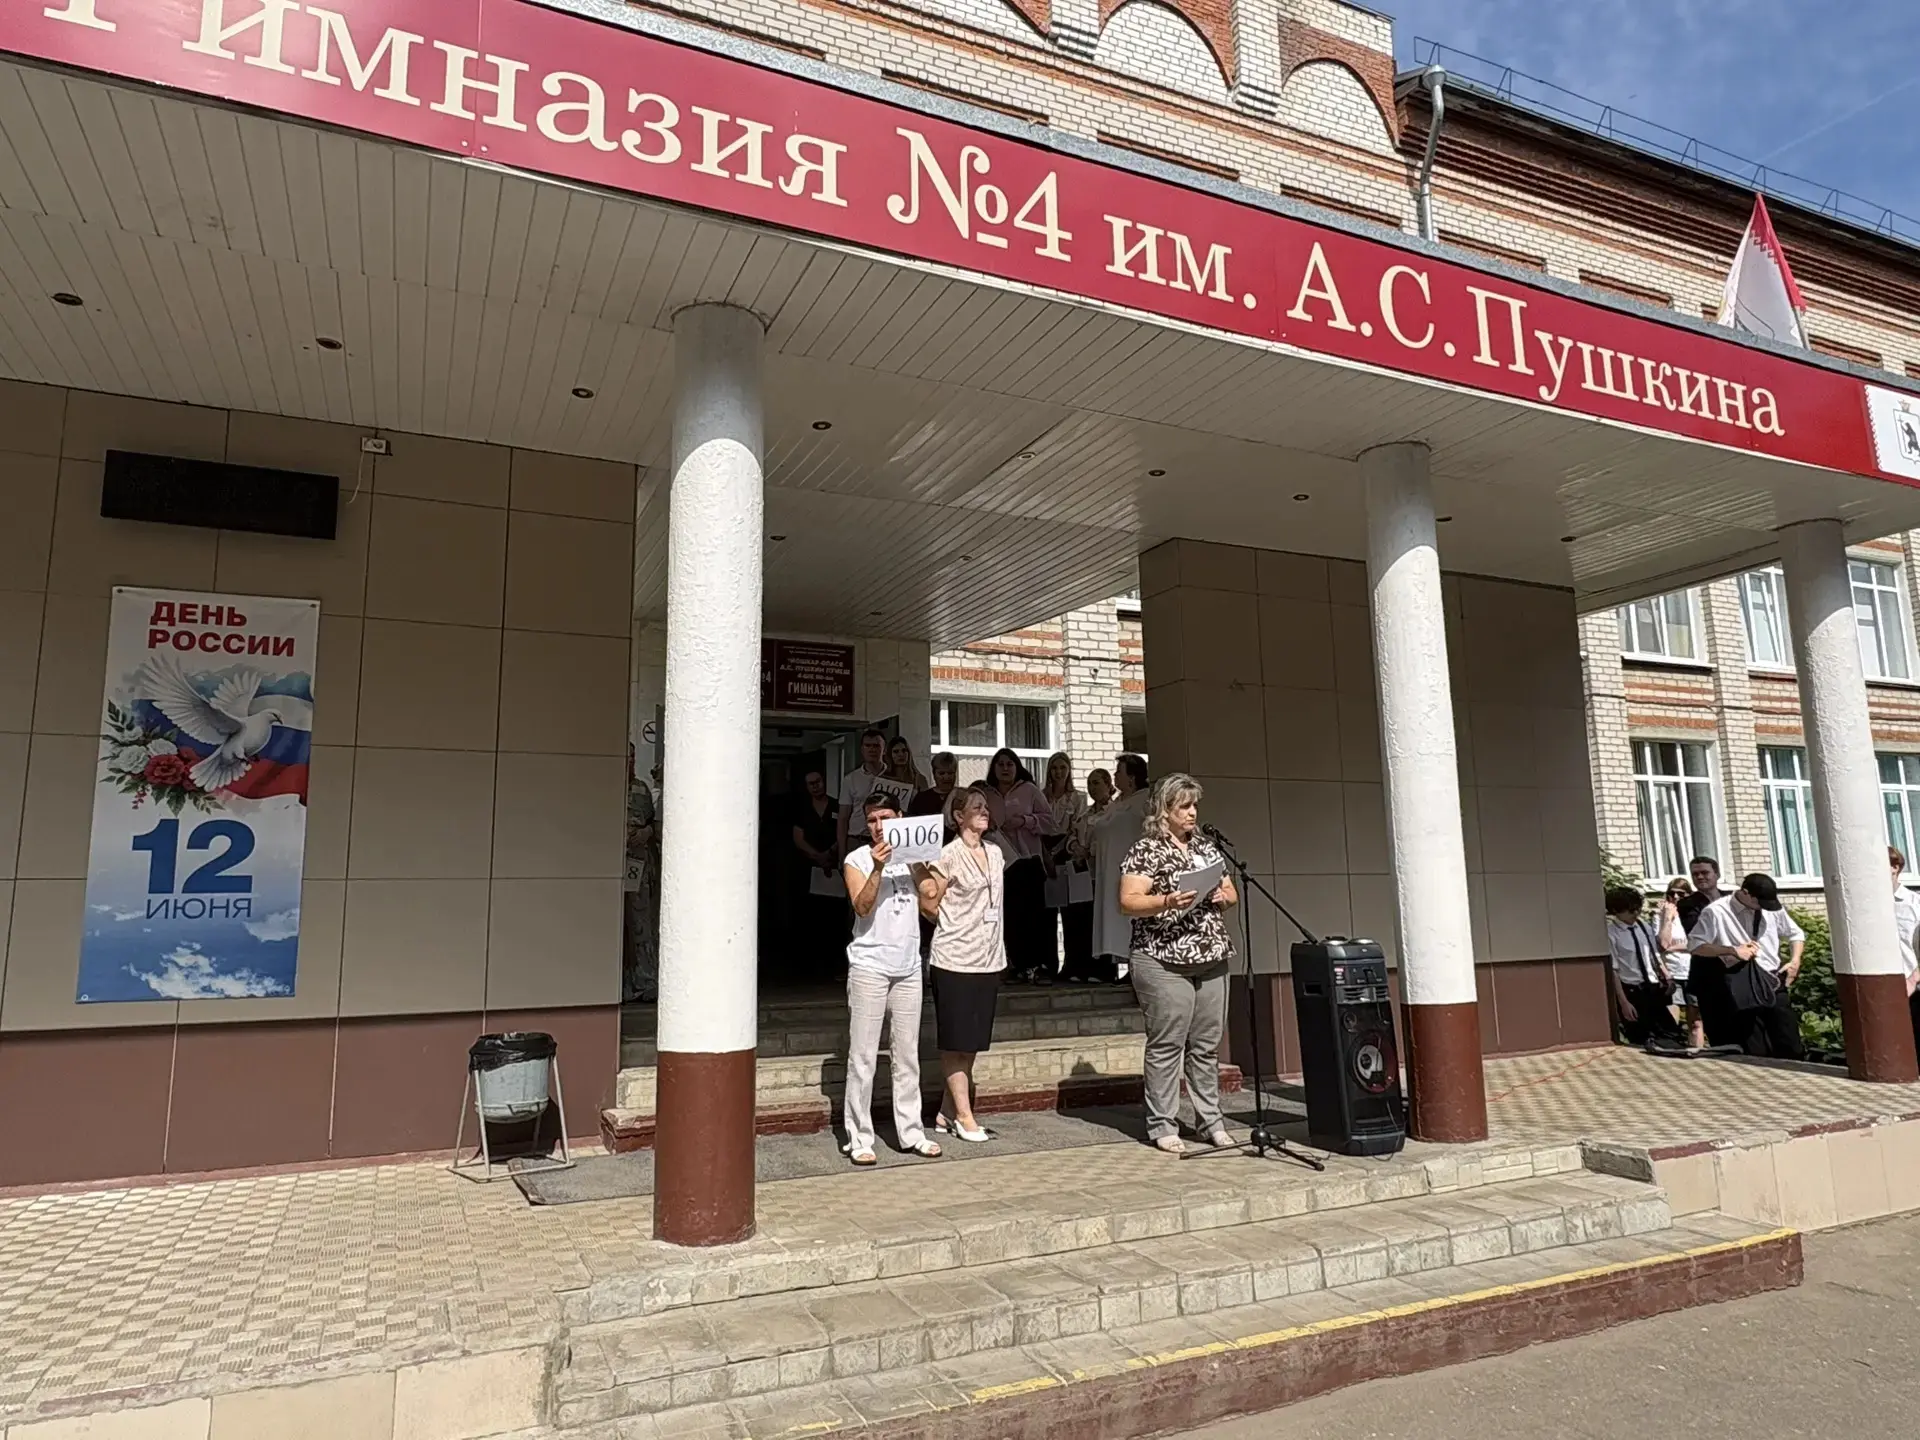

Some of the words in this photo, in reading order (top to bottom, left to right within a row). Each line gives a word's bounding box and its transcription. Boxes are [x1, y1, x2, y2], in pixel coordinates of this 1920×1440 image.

[44, 0, 848, 208] имназия
[886, 126, 1073, 263] №4
[1103, 213, 1257, 310] им.
[150, 601, 248, 627] ДЕНЬ
[148, 628, 295, 657] РОССИИ
[888, 823, 939, 850] 0106
[132, 818, 256, 894] 12
[145, 898, 253, 920] ИЮНЯ
